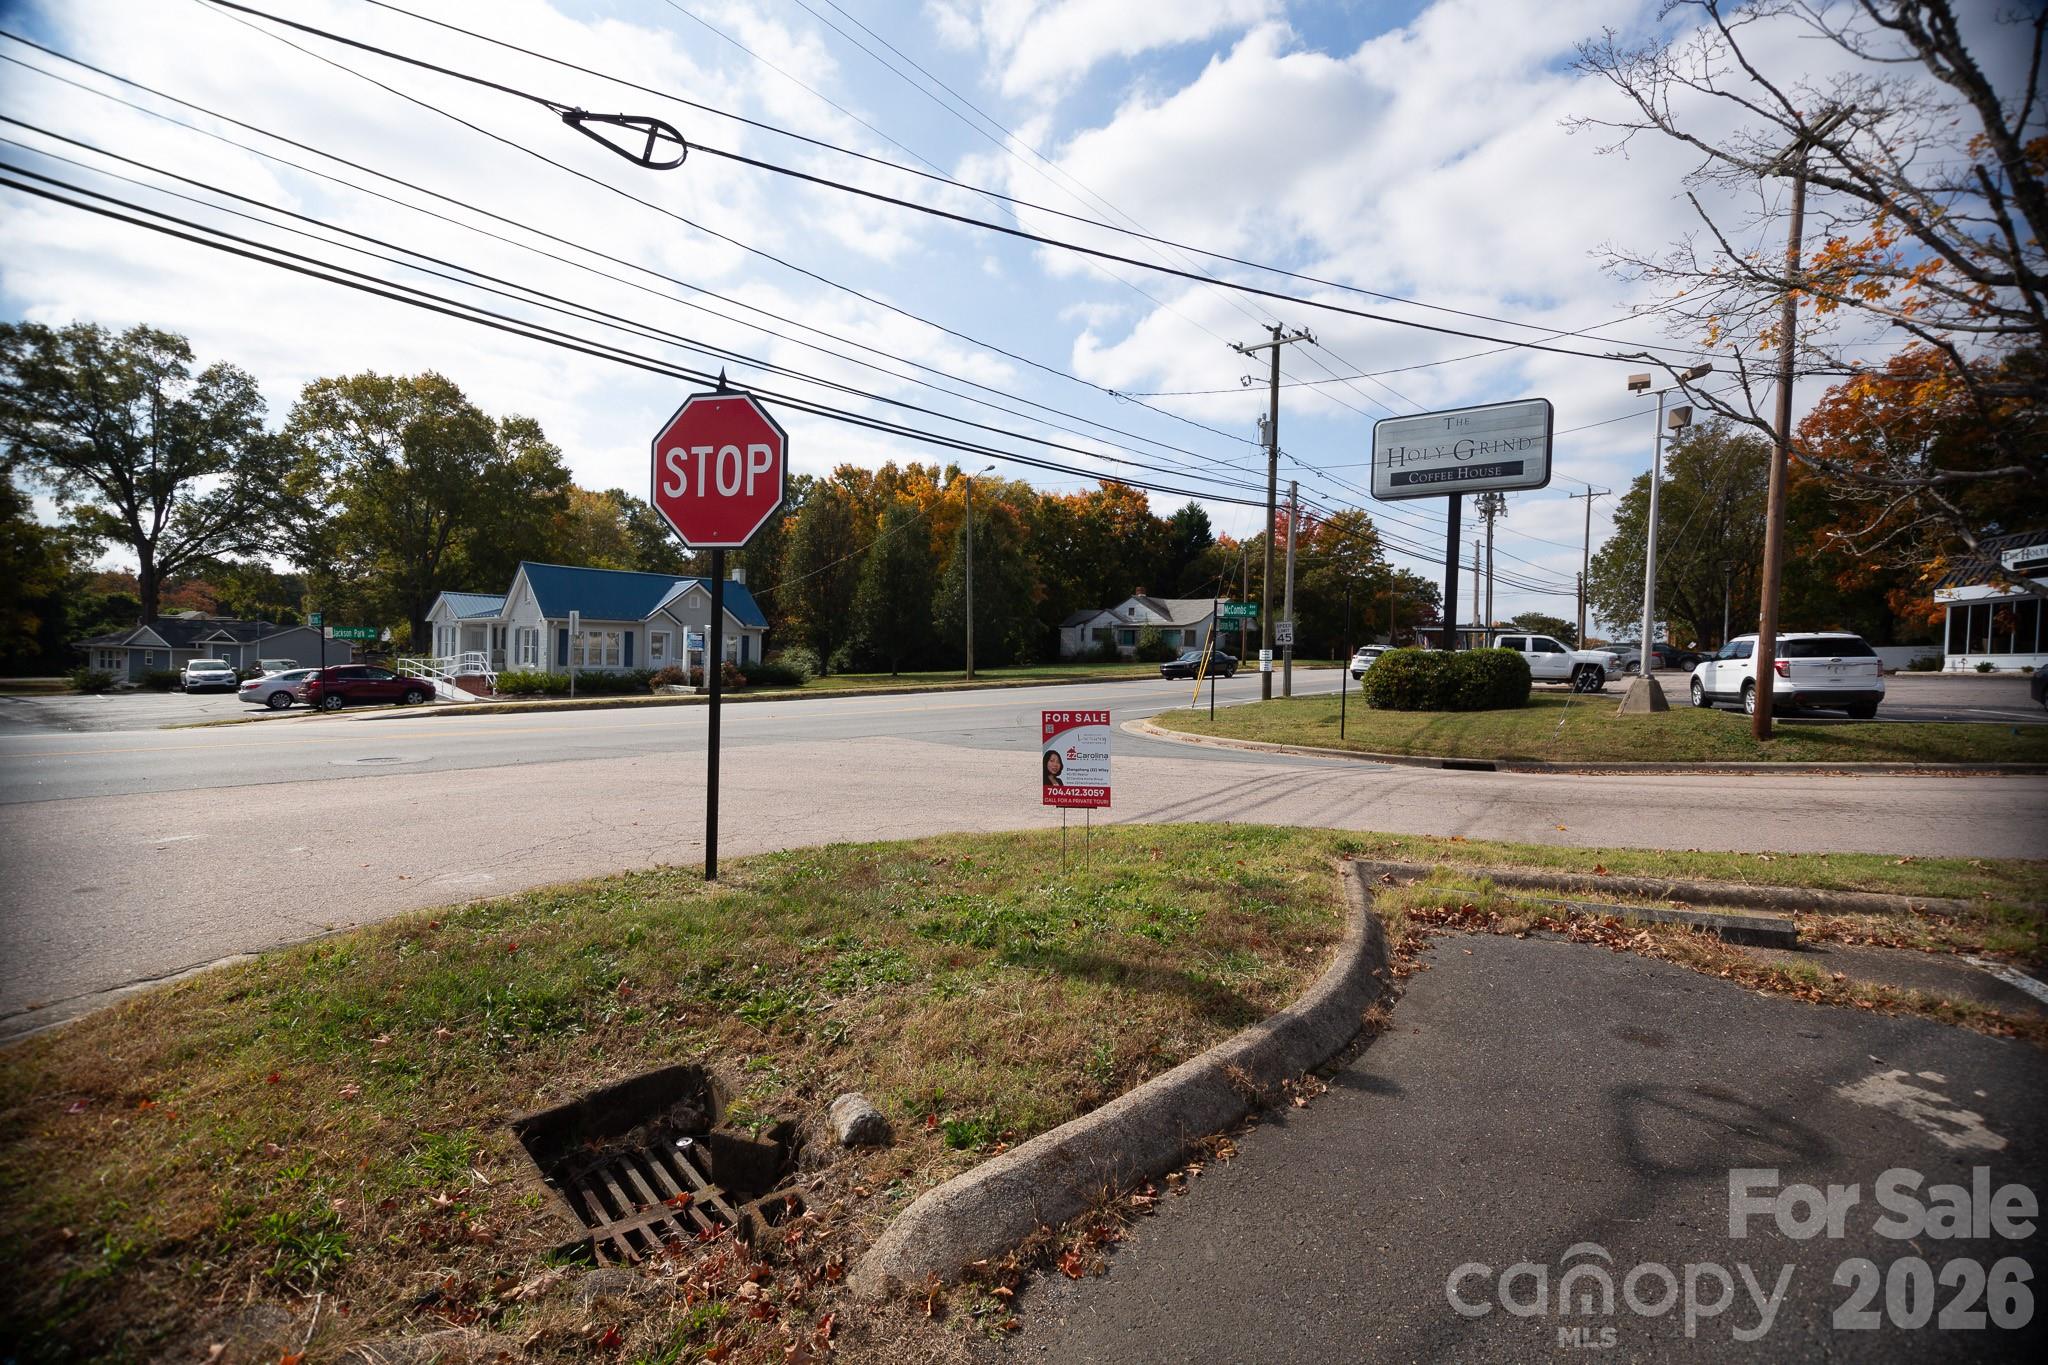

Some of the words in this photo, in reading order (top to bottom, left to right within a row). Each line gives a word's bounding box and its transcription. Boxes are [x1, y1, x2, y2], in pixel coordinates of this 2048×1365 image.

[1443, 417, 1471, 430] THE
[1387, 446, 1445, 469] HOLY
[1453, 437, 1532, 461] GRIND
[663, 443, 773, 498] STOP
[1408, 471, 1454, 484] COFFEE
[1457, 466, 1502, 479] HOUSE
[1224, 604, 1247, 615] McCombs
[333, 628, 353, 638] Jackson
[353, 628, 365, 638] Park
[1276, 633, 1292, 642] 45
[1045, 713, 1070, 723] FOR
[1075, 713, 1107, 723] SALE
[1047, 787, 1105, 797] 704.412.3059
